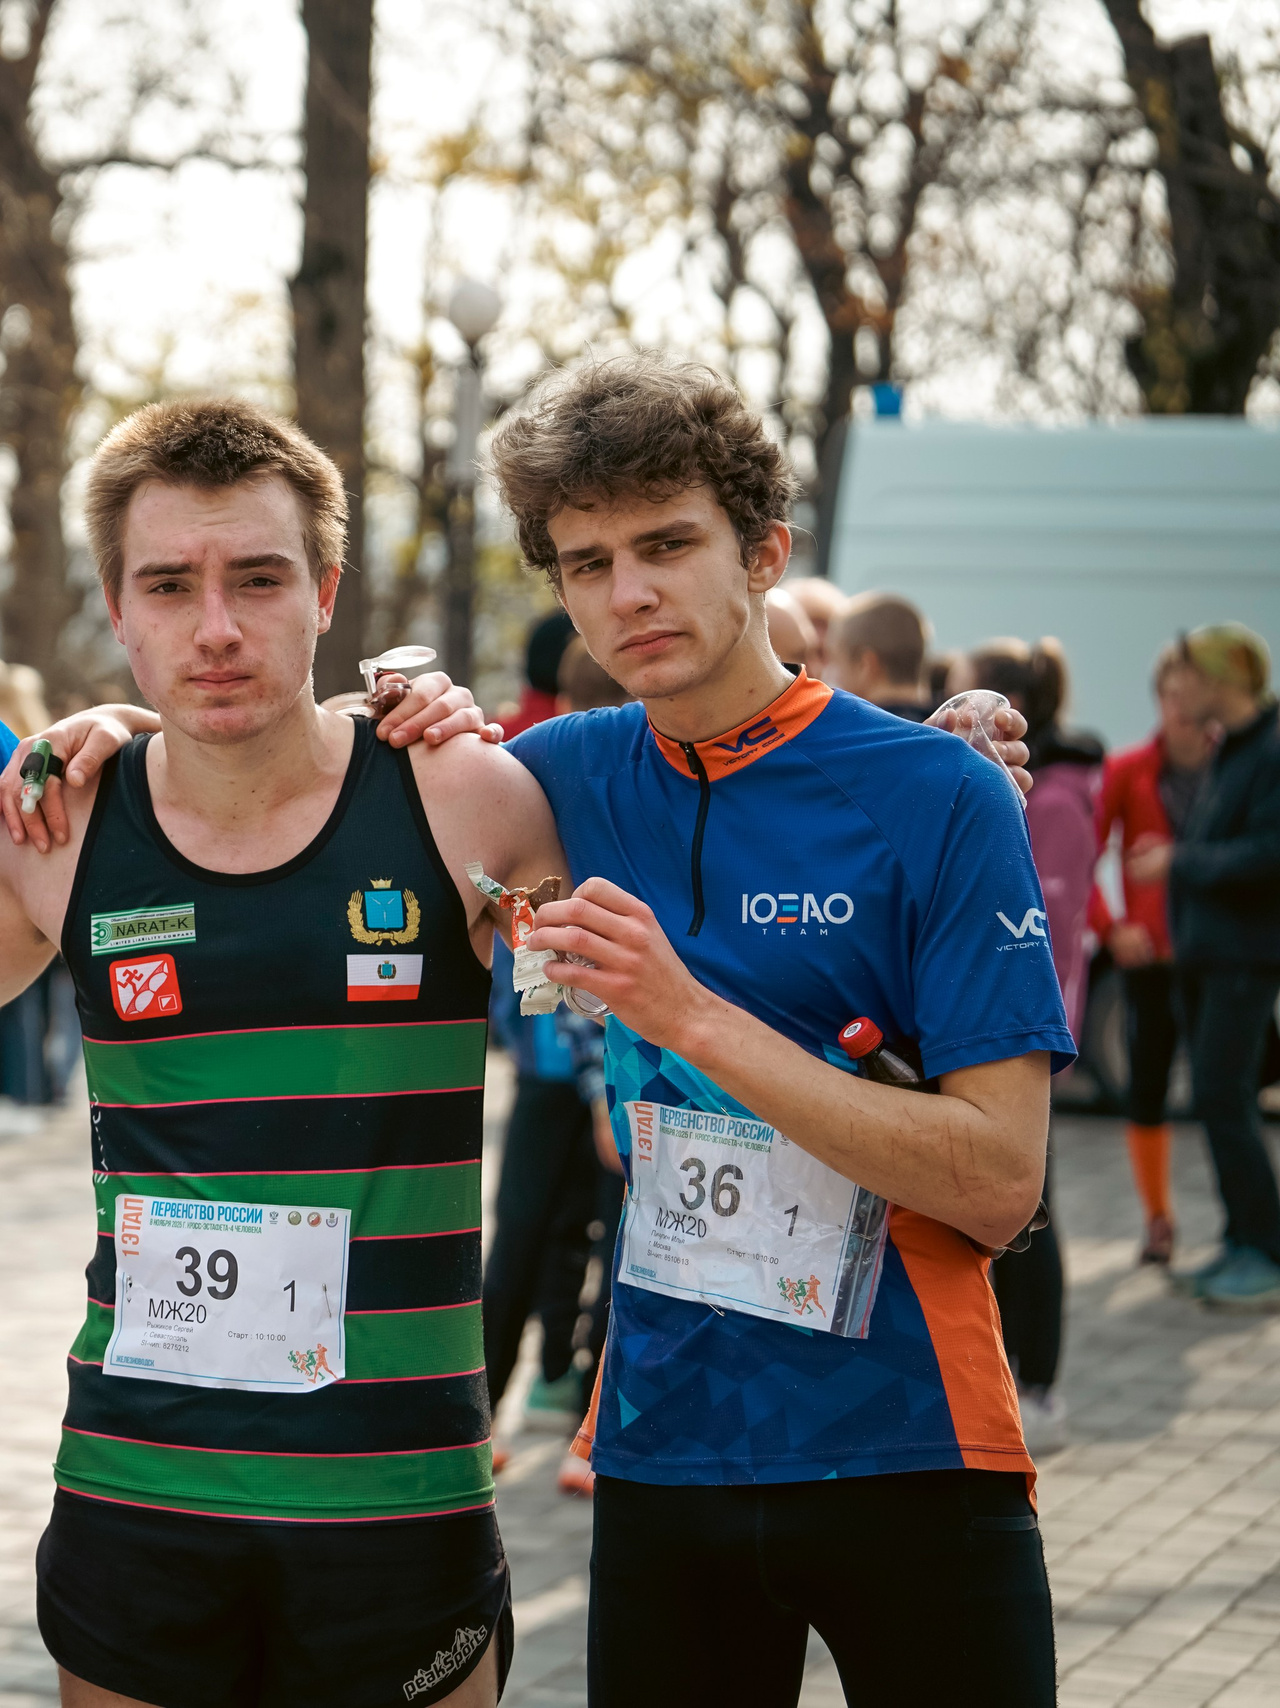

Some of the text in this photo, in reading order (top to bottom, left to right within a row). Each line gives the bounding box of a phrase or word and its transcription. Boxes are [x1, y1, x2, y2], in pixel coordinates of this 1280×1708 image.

[723, 732, 785, 767] VICTORY CODE
[116, 917, 190, 937] NARAT-K
[762, 927, 828, 936] TEAM
[132, 935, 161, 943] LIABILITY
[996, 941, 1039, 951] VICTORY
[633, 1102, 654, 1151] ЭТАП
[660, 1106, 775, 1143] ПЕРВЕНСТВО РОССИИ
[743, 1141, 771, 1153] ЧЕЛОВЕКА
[679, 1157, 744, 1217] 36
[121, 1198, 144, 1246] ЭТАП
[150, 1200, 263, 1224] ПЕРВЕНСТВО РОССИИ
[784, 1204, 799, 1237] 1
[171, 1220, 182, 1229] 2025
[235, 1226, 262, 1234] ЧЕЛОВЕКА
[655, 1207, 707, 1238] МЖ20
[653, 1240, 671, 1251] Москва
[727, 1248, 746, 1258] Старт
[175, 1246, 239, 1300] 39
[283, 1280, 296, 1312] 1
[148, 1298, 207, 1324] МЖ20
[146, 1321, 194, 1333] Рыжиков Сергей
[227, 1331, 248, 1341] Старт
[255, 1332, 286, 1342] 10:10:00
[150, 1332, 188, 1343] Севастополь
[163, 1343, 190, 1353] 8275212
